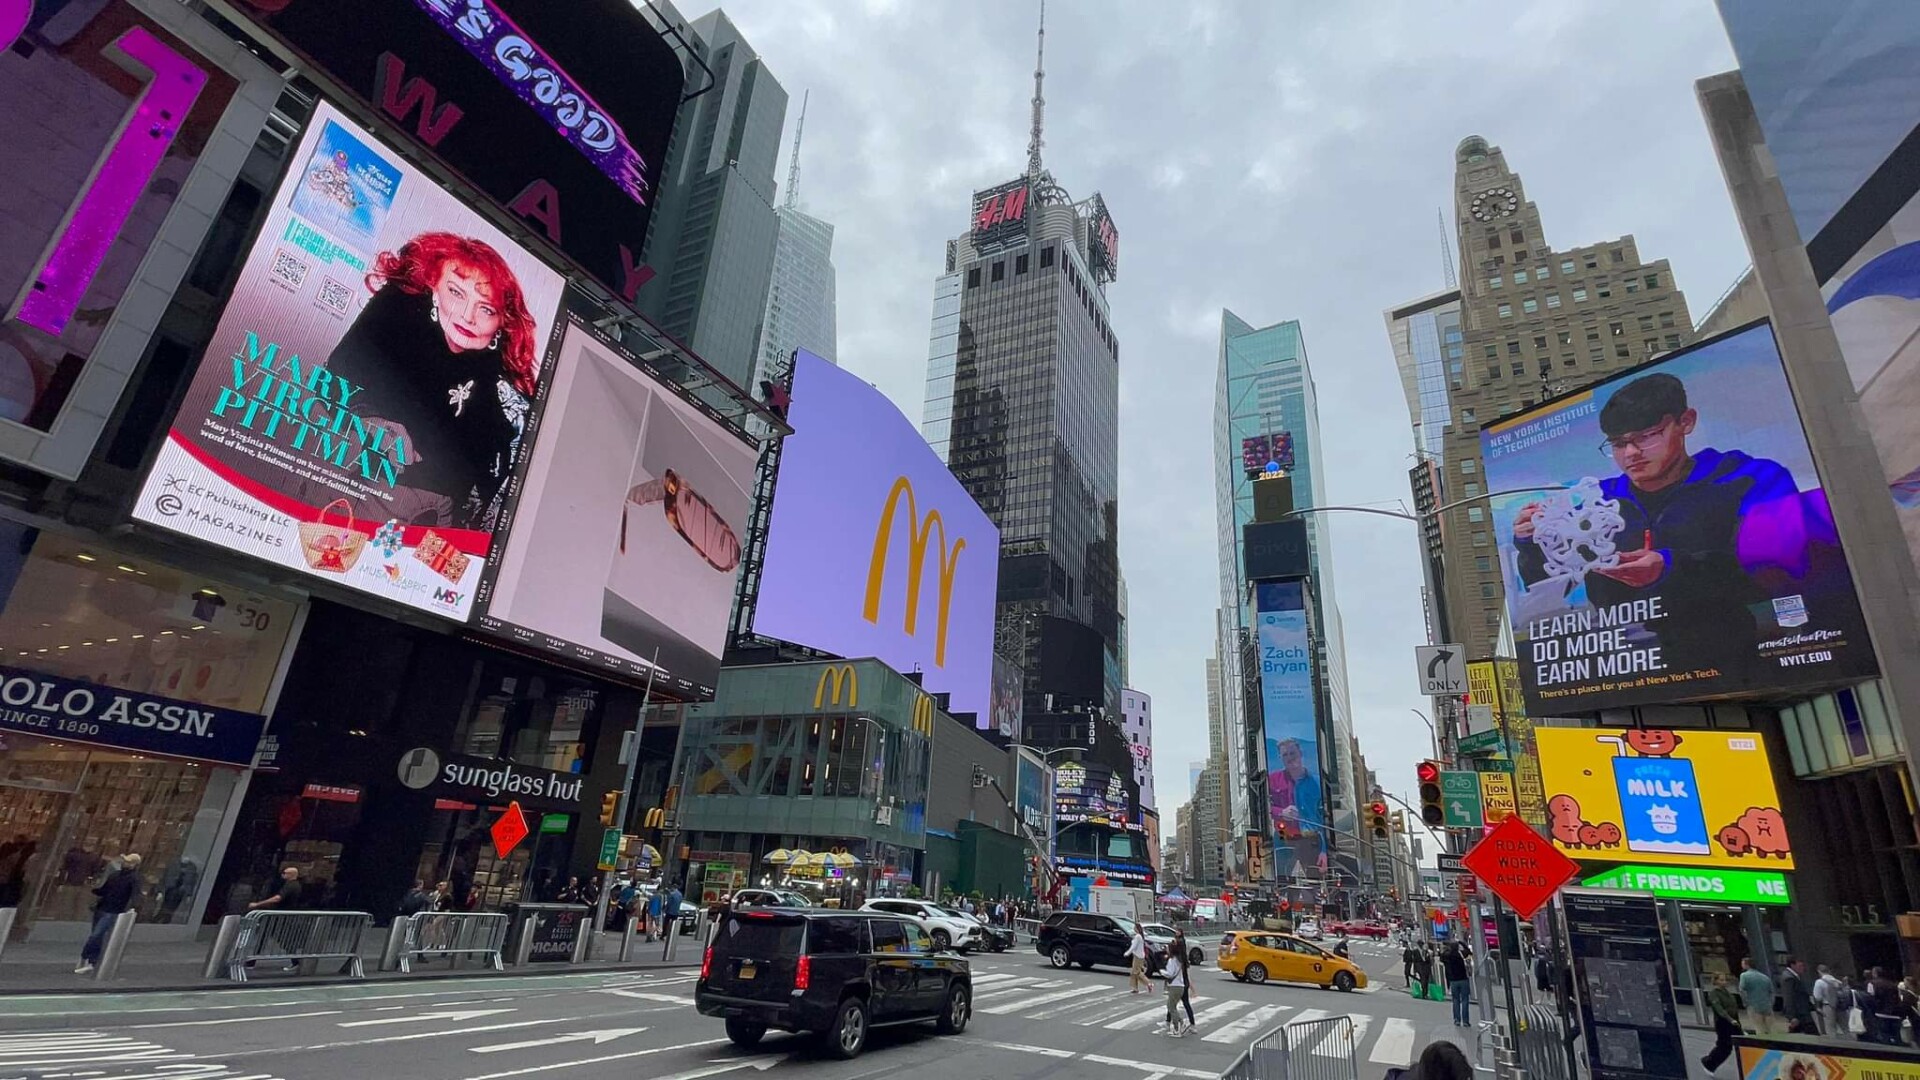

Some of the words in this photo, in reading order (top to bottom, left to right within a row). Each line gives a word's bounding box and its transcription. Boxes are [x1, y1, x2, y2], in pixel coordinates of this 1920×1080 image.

[975, 184, 1028, 233] H&M
[235, 329, 365, 408] MARY
[230, 356, 406, 465] VIRGINIA
[210, 386, 403, 488] PITTMAN
[1490, 433, 1512, 447] NEW
[1514, 423, 1541, 439] YORK
[1543, 402, 1598, 428] INSTITUTE
[1492, 448, 1503, 459] OF
[1505, 423, 1570, 454] TECHNOLOGY
[200, 429, 225, 443] word
[225, 436, 235, 448] of
[295, 467, 311, 479] and
[204, 418, 229, 434] Mary
[230, 427, 264, 448] Virginia
[264, 441, 296, 461] Pittman
[298, 457, 307, 467] on
[309, 460, 321, 472] her
[322, 466, 350, 484] mission
[351, 479, 358, 488] to
[382, 489, 394, 501] the
[1258, 469, 1285, 480] 2022
[206, 491, 268, 521] Publishing
[187, 508, 283, 548] MAGAZINES
[236, 606, 271, 631] $30
[1529, 609, 1593, 641] LEARN
[1599, 596, 1668, 628] MORE.
[1265, 645, 1304, 659] Zach
[1533, 639, 1559, 662] DO
[1566, 628, 1633, 658] MORE.
[1263, 660, 1308, 675] Bryan
[1537, 658, 1590, 685] EARN
[1597, 647, 1668, 678] MORE.
[1779, 650, 1832, 667] NYIT.EDU
[0, 674, 95, 716] OLO
[1428, 680, 1461, 691] ONLY
[1471, 679, 1492, 690] MOVE
[1539, 687, 1569, 699] There's
[1577, 684, 1601, 697] place
[1602, 682, 1615, 692] for
[1617, 681, 1634, 691] you
[1635, 678, 1645, 687] at
[1647, 675, 1668, 685] New
[1669, 672, 1693, 682] York
[1473, 690, 1494, 705] YOU
[57, 719, 100, 735] 1890
[1088, 713, 1096, 745] 1500
[443, 763, 544, 798] sunglass
[546, 775, 584, 802] hut
[1487, 773, 1504, 781] THE
[1627, 778, 1689, 798] MILK
[1485, 784, 1508, 797] LION
[1485, 797, 1514, 810] KING
[1496, 839, 1536, 852] ROAD
[1499, 857, 1538, 869] WORK
[1496, 873, 1547, 888] AHEAD
[1636, 872, 1725, 893] FRIENDS
[532, 941, 575, 953] HICAGO
